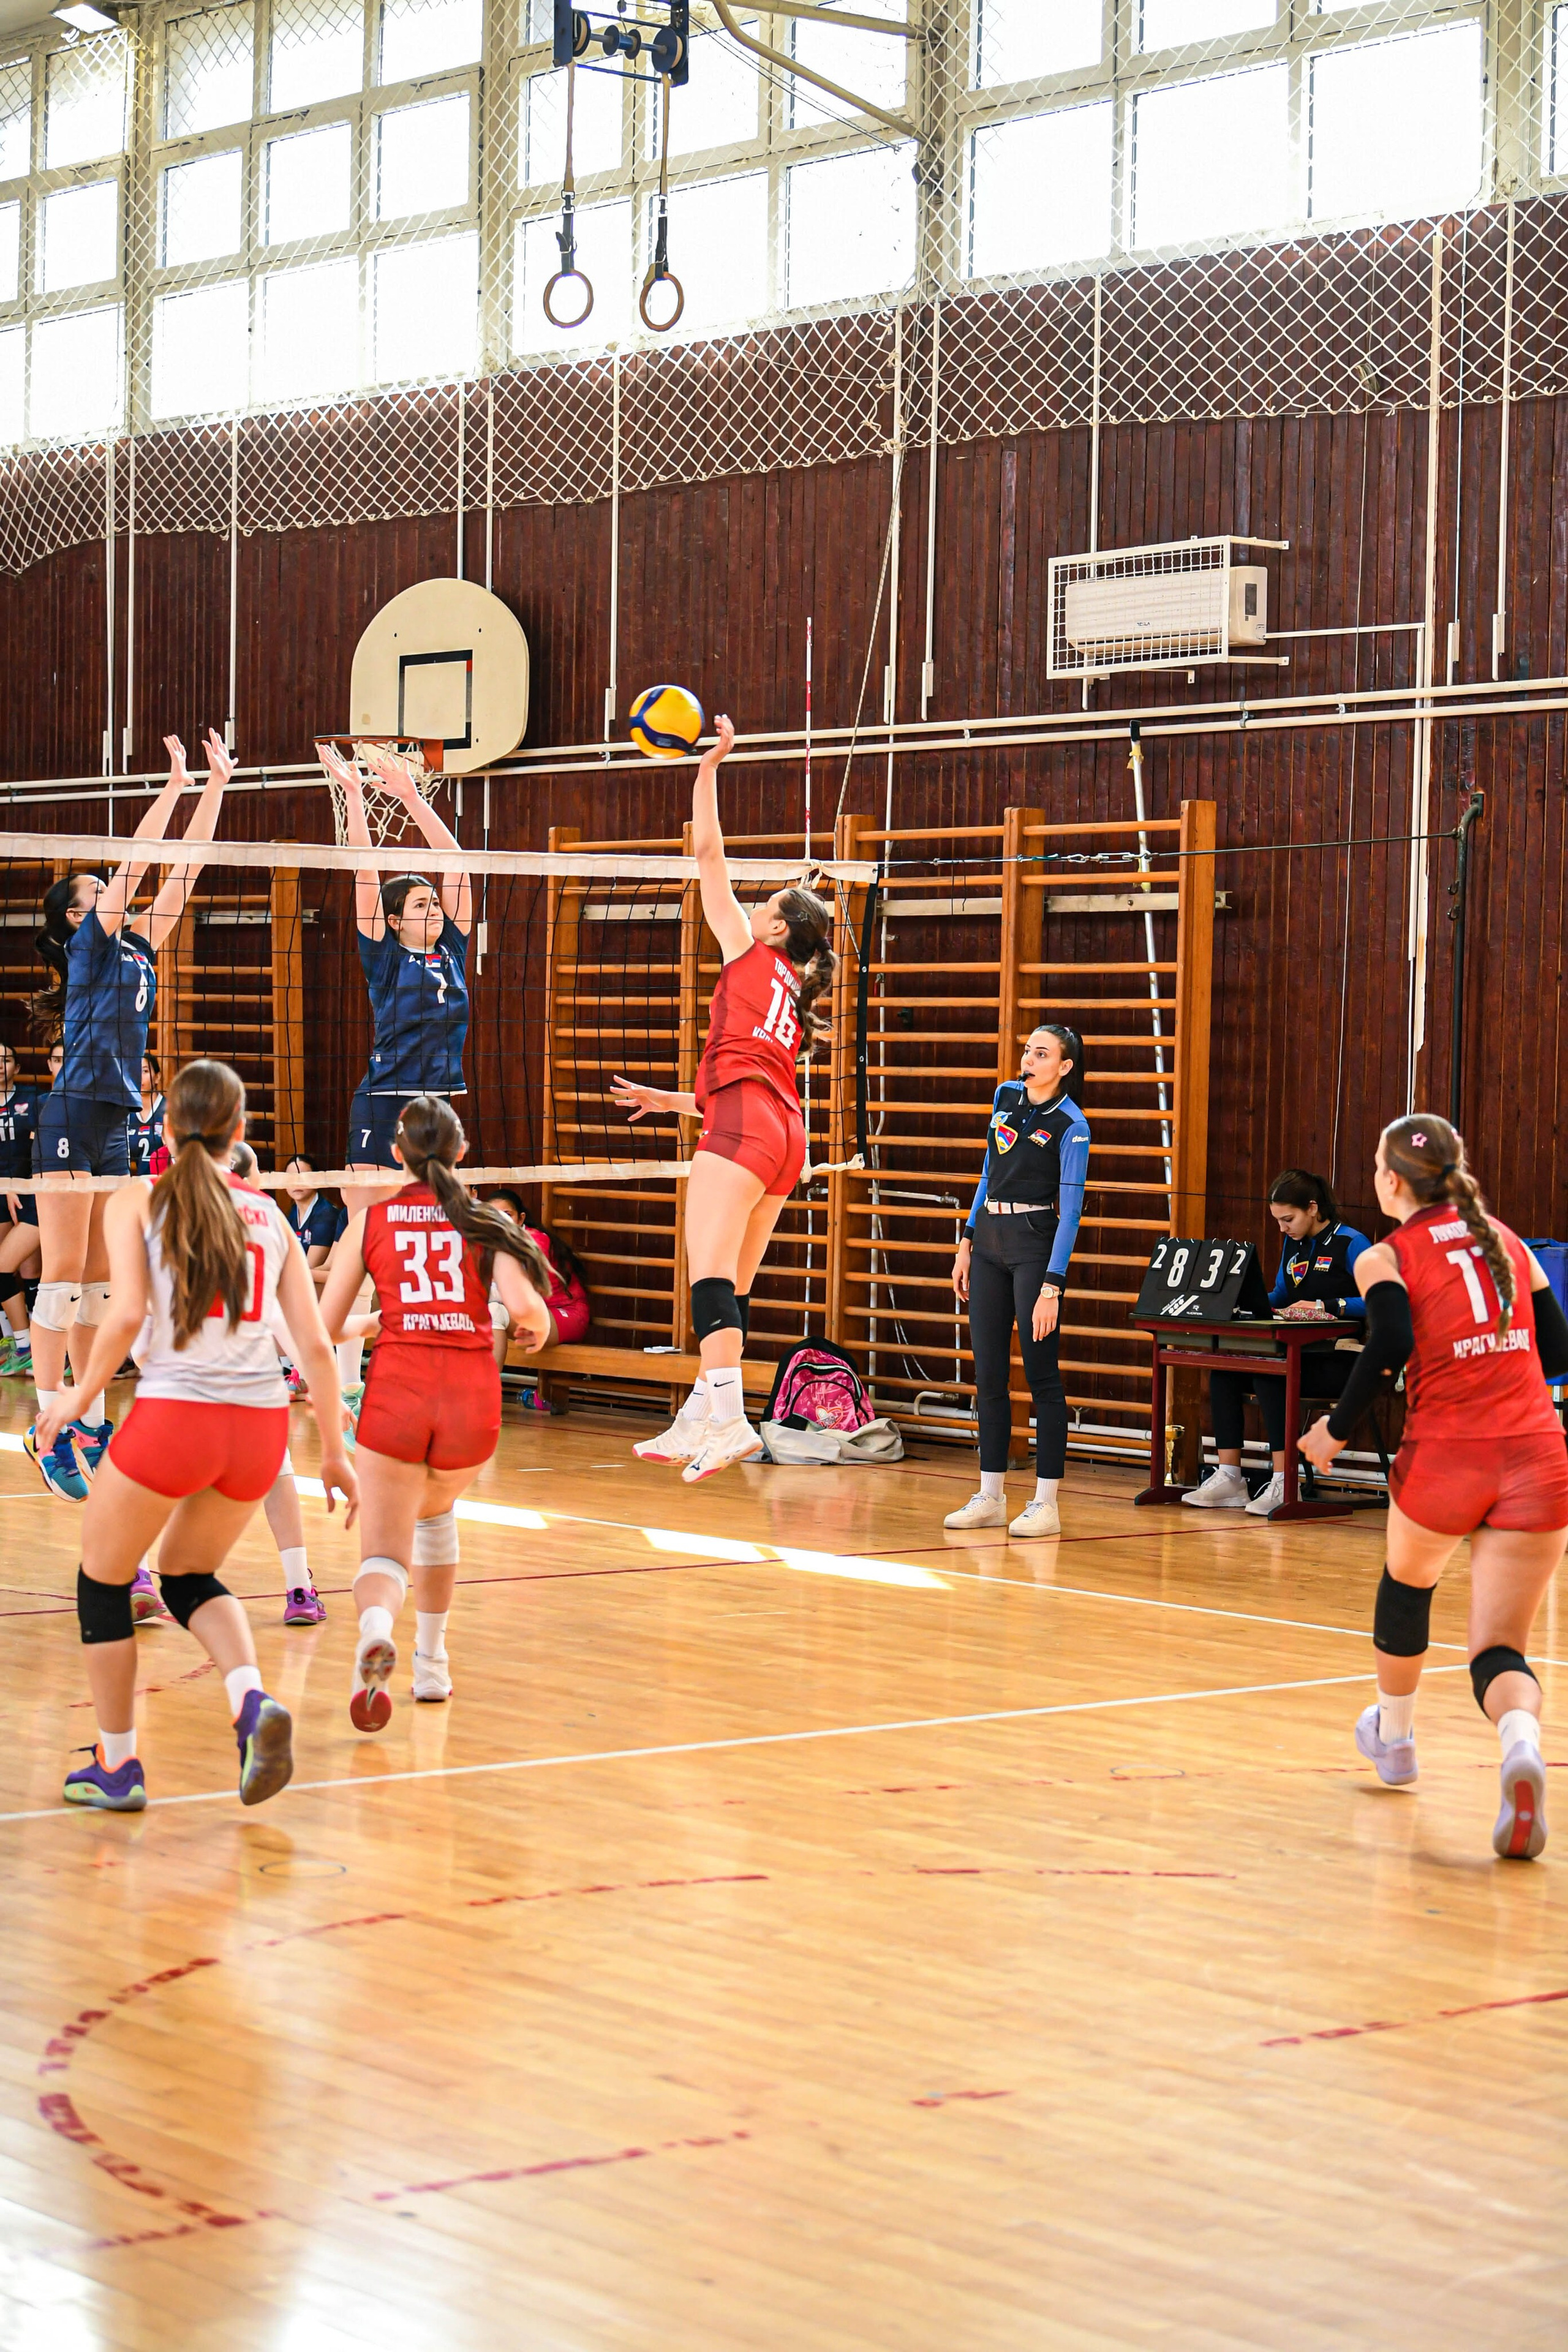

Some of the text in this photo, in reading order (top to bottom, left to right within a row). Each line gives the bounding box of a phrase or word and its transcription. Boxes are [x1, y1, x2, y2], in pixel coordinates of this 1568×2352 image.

[431, 972, 448, 1004] 7
[763, 978, 797, 1050] 16
[57, 1137, 70, 1158] 8
[138, 1137, 151, 1162] 2
[361, 1129, 371, 1148] 7
[387, 1204, 450, 1223] МИЛЕНКО
[394, 1230, 466, 1304] 33
[1152, 1244, 1246, 1288] 2 8 3 2
